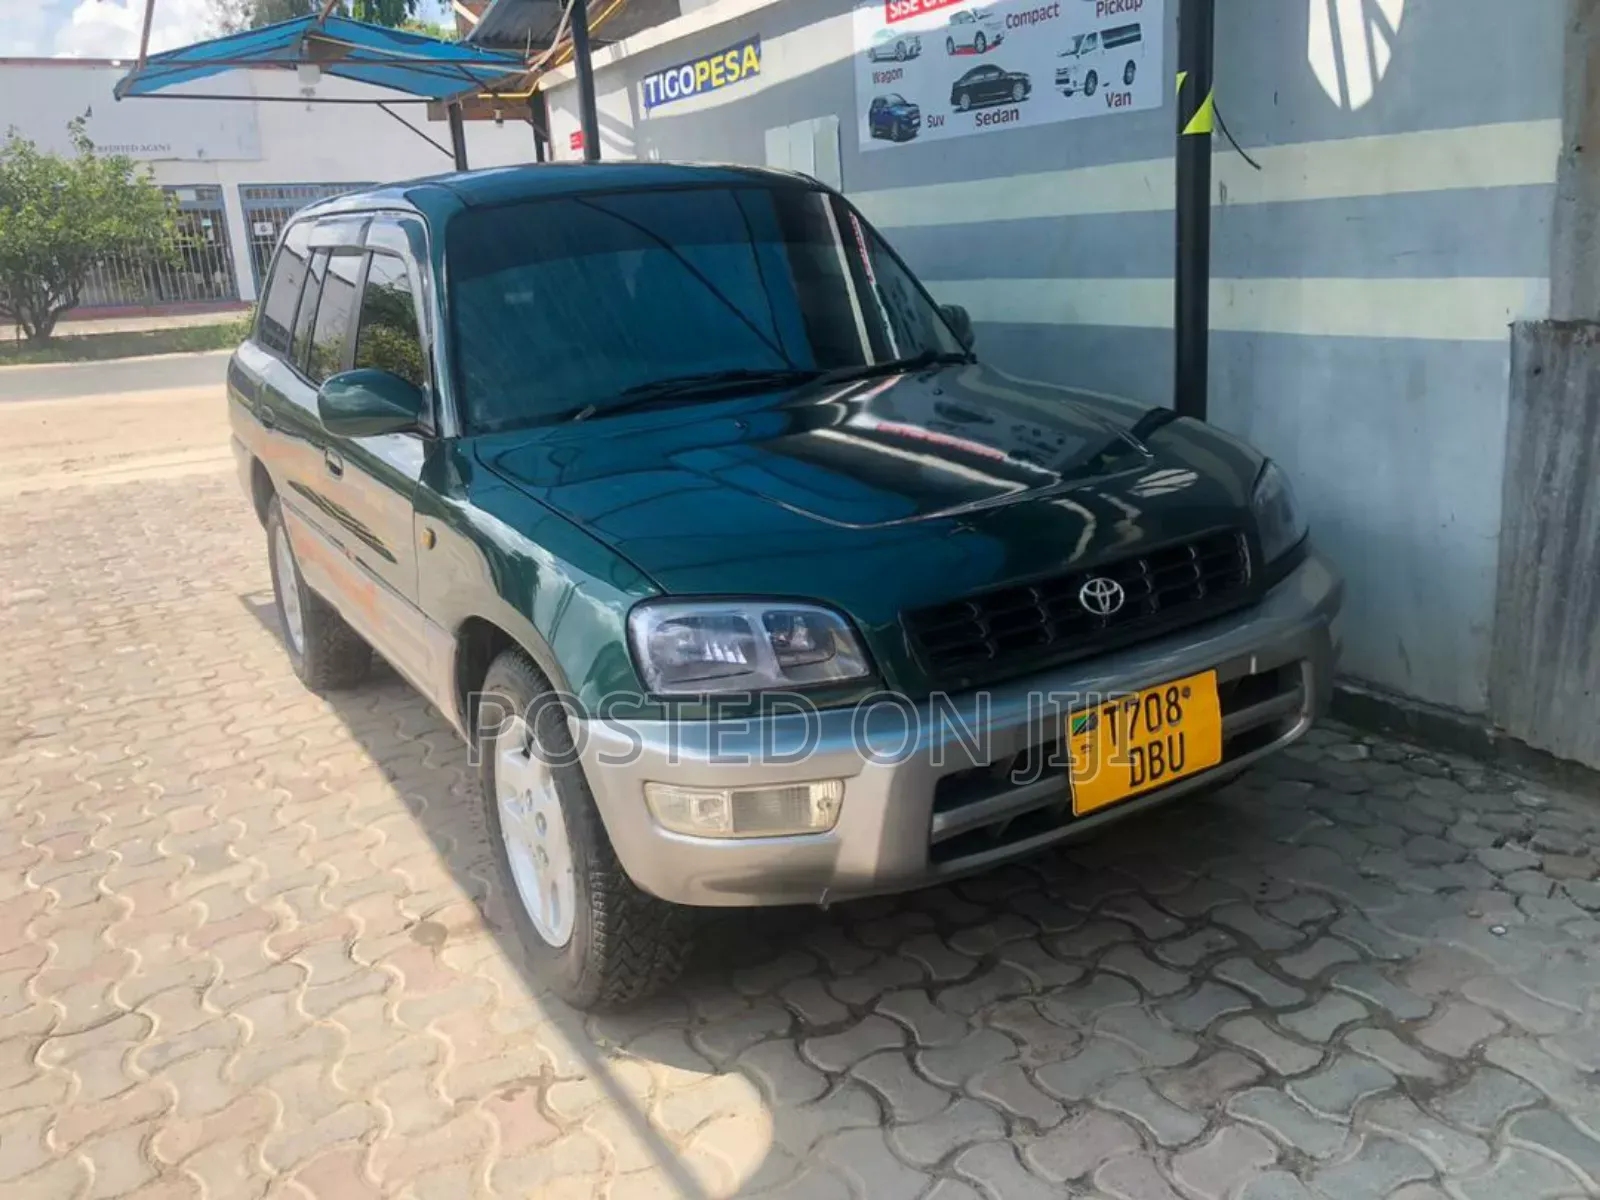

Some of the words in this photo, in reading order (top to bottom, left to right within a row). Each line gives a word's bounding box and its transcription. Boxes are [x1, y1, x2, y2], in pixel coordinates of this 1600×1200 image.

[1005, 3, 1060, 29] Compact
[644, 43, 760, 105] TIGOPESA
[872, 67, 903, 84] Wagon
[1105, 90, 1132, 109] Van
[975, 106, 1020, 127] Sedan
[1103, 686, 1182, 746] T708
[1129, 732, 1185, 787] DBU
